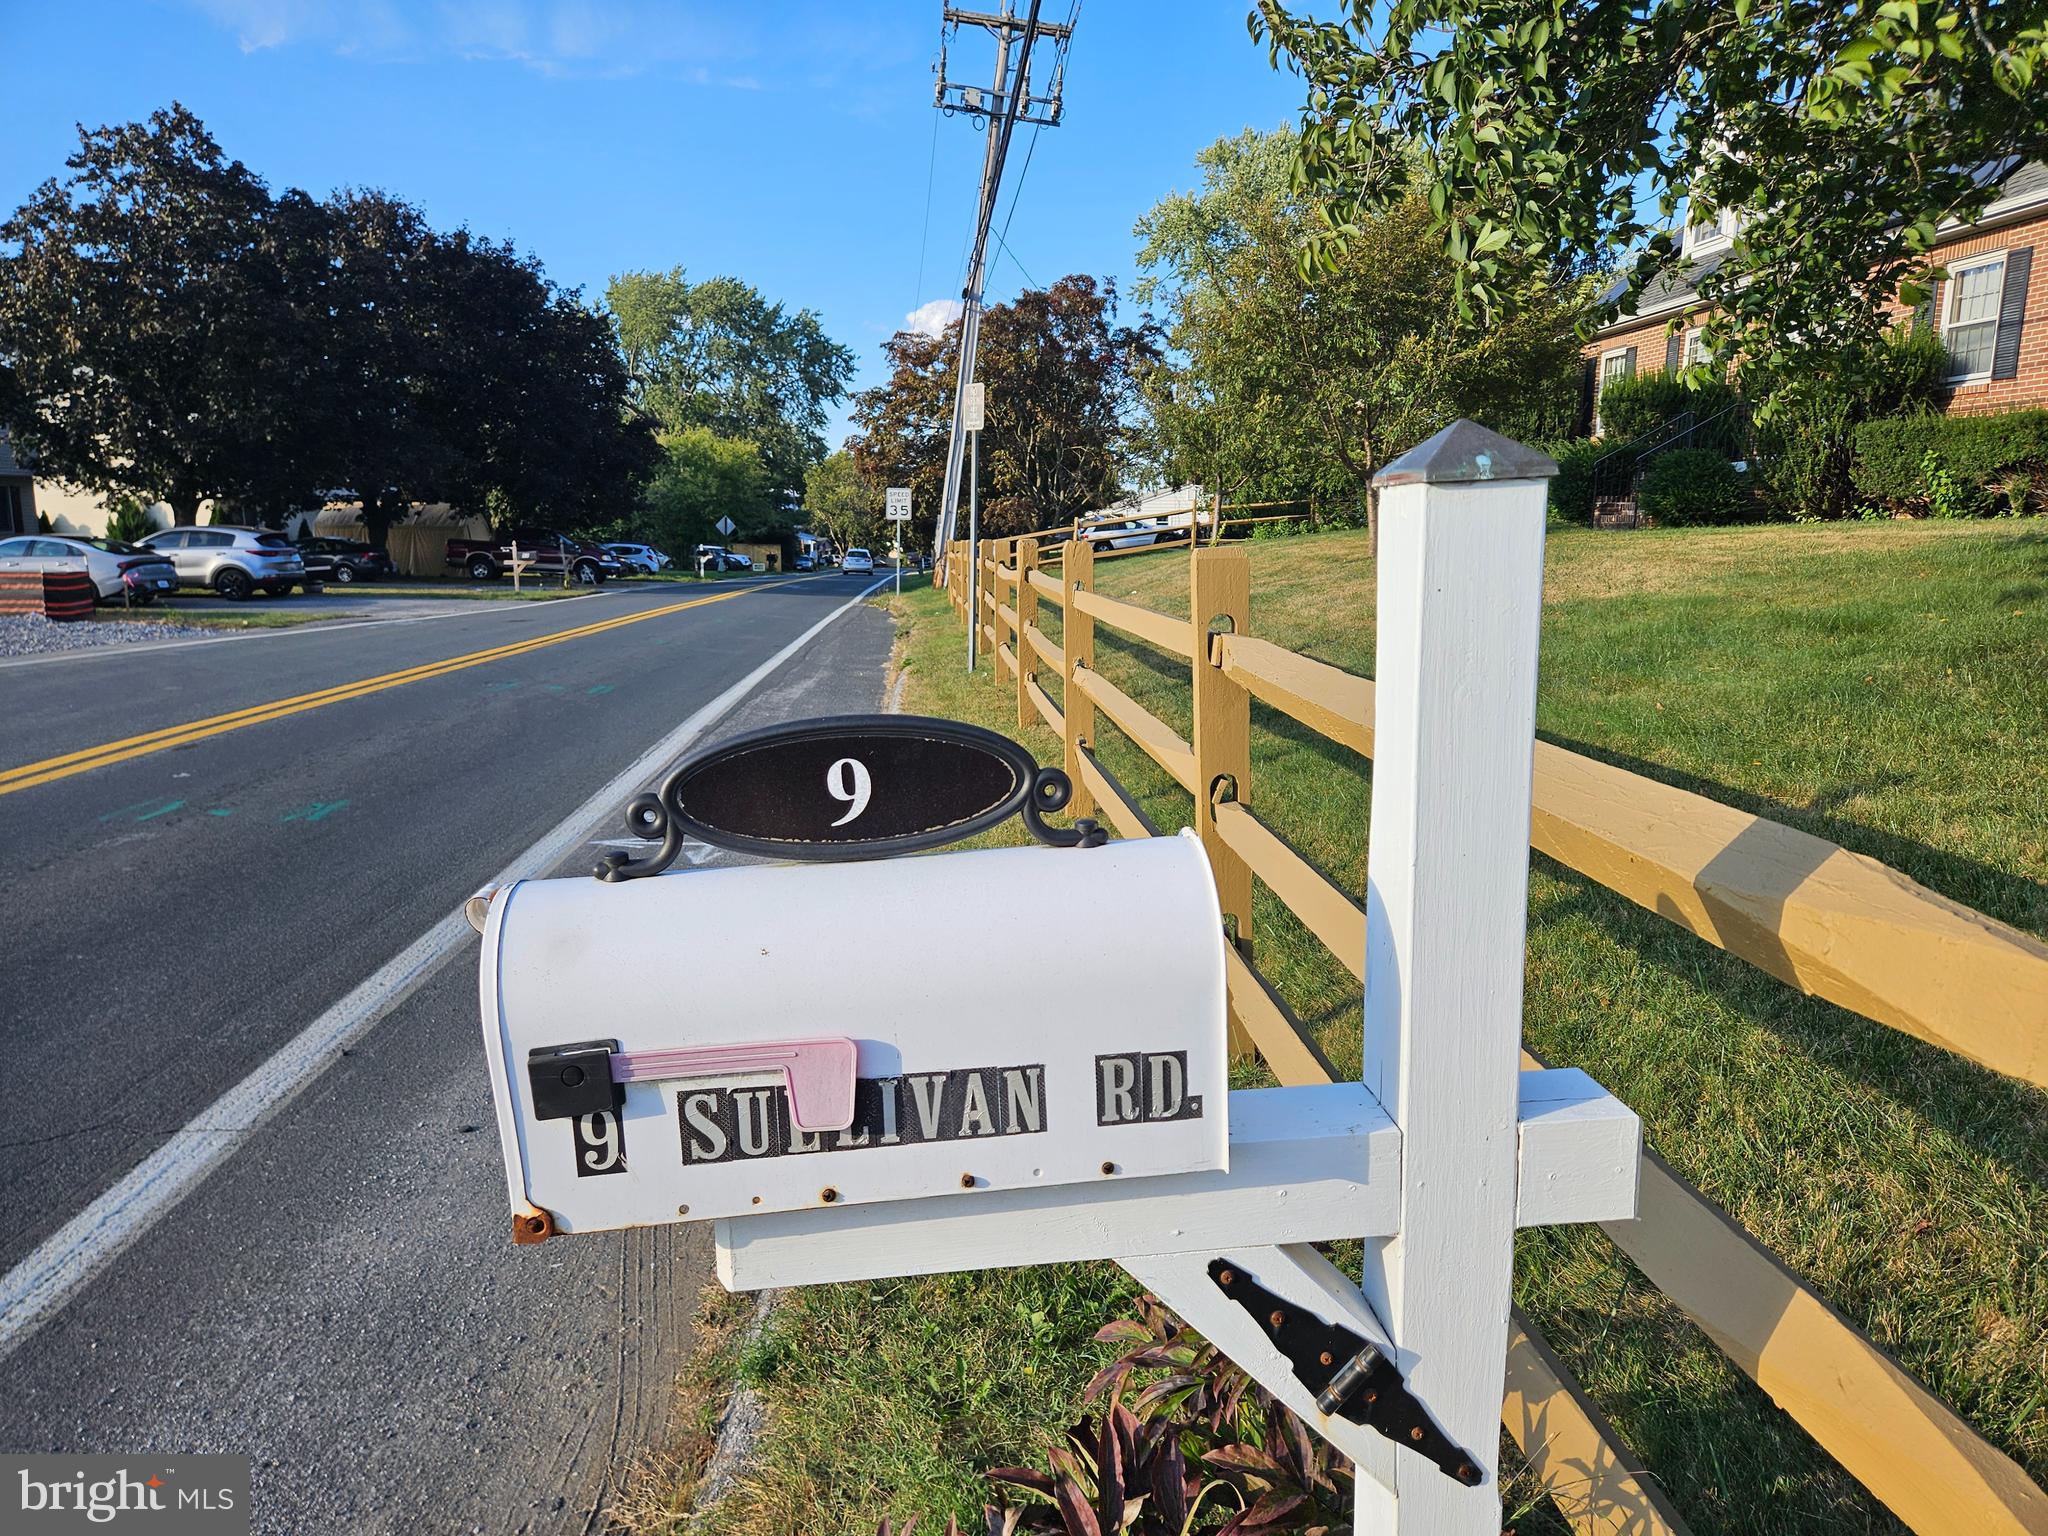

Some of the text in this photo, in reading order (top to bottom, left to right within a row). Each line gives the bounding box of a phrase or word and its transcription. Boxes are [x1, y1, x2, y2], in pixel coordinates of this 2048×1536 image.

[889, 504, 909, 516] 35
[826, 758, 872, 828] 9
[580, 1054, 1199, 1170] 9 SUIVAN RD.
